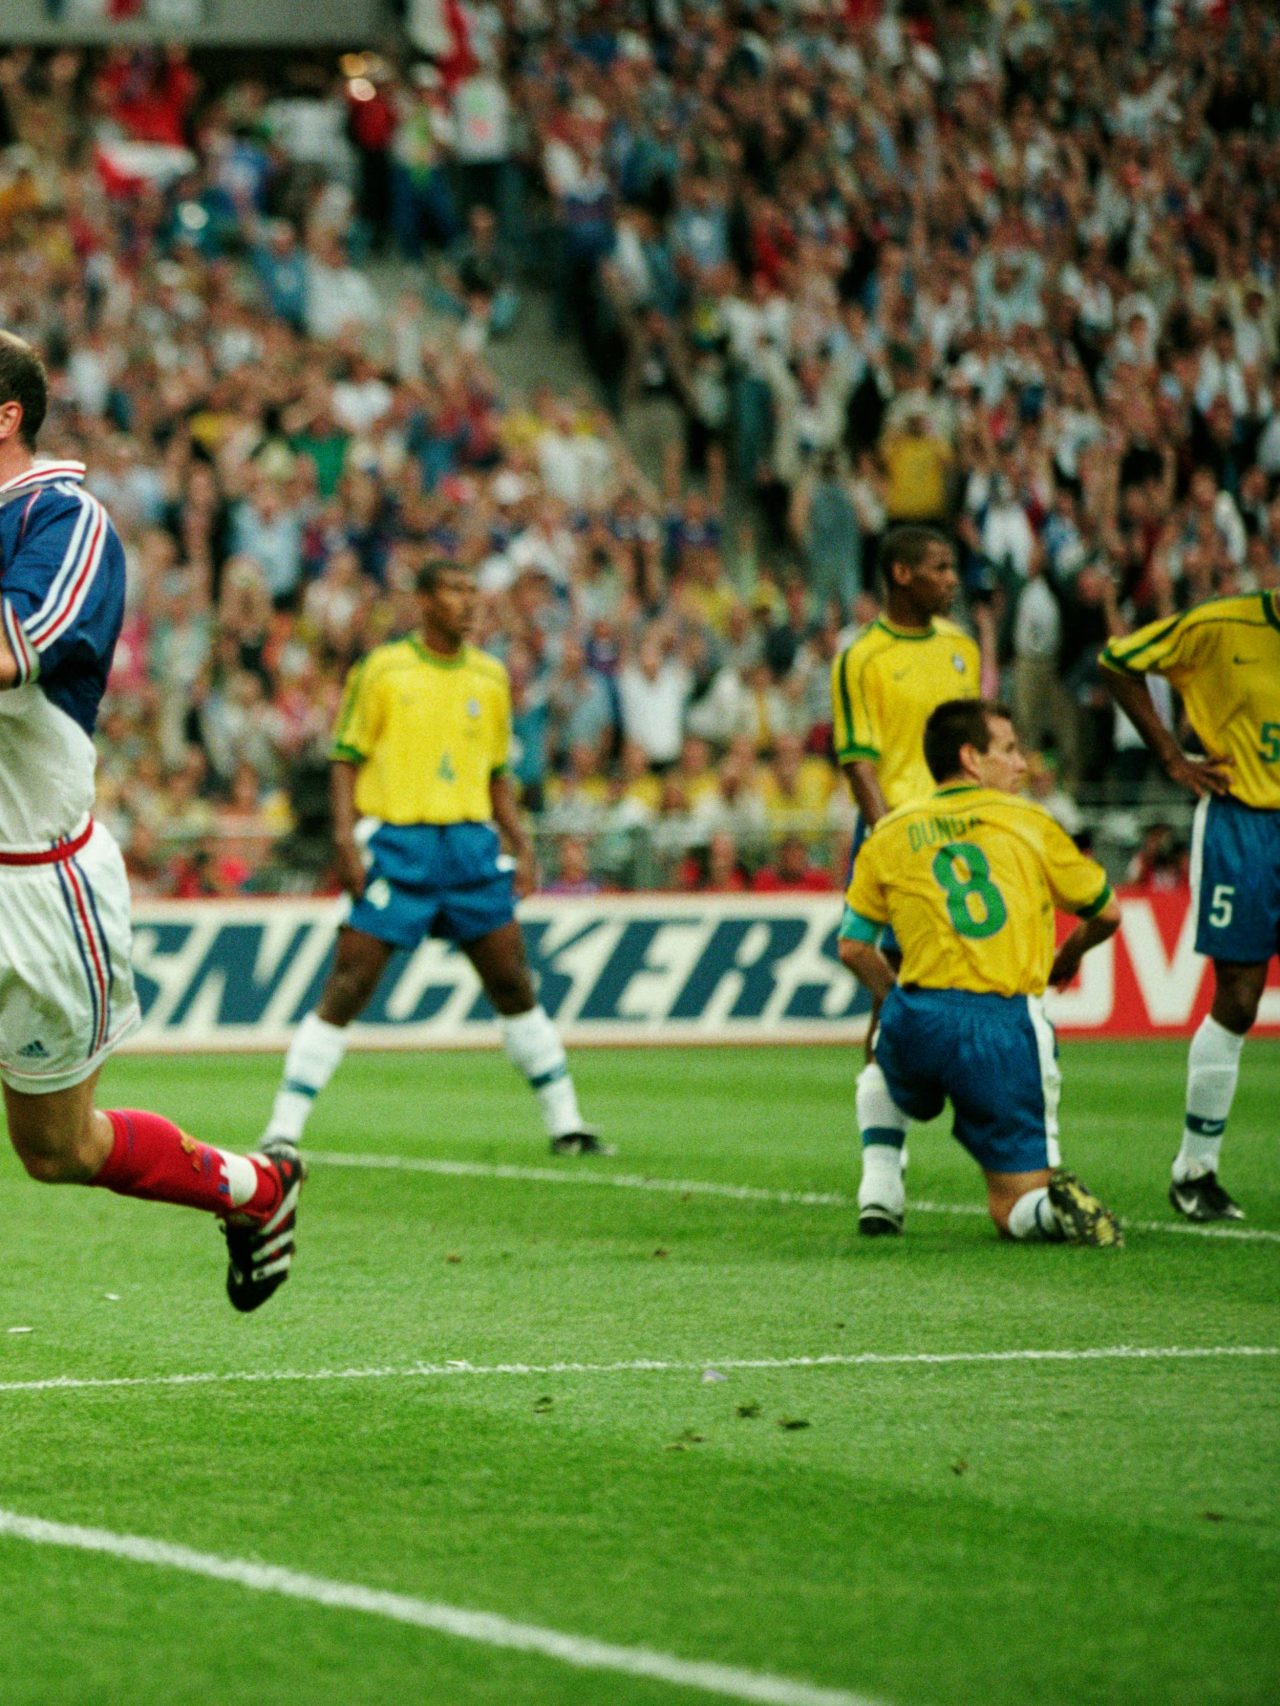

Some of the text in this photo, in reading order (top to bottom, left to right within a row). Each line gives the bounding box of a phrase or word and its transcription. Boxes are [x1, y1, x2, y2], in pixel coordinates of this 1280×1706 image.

[931, 840, 1008, 940] 8
[1208, 885, 1235, 928] 5
[1044, 897, 1280, 1028] JV
